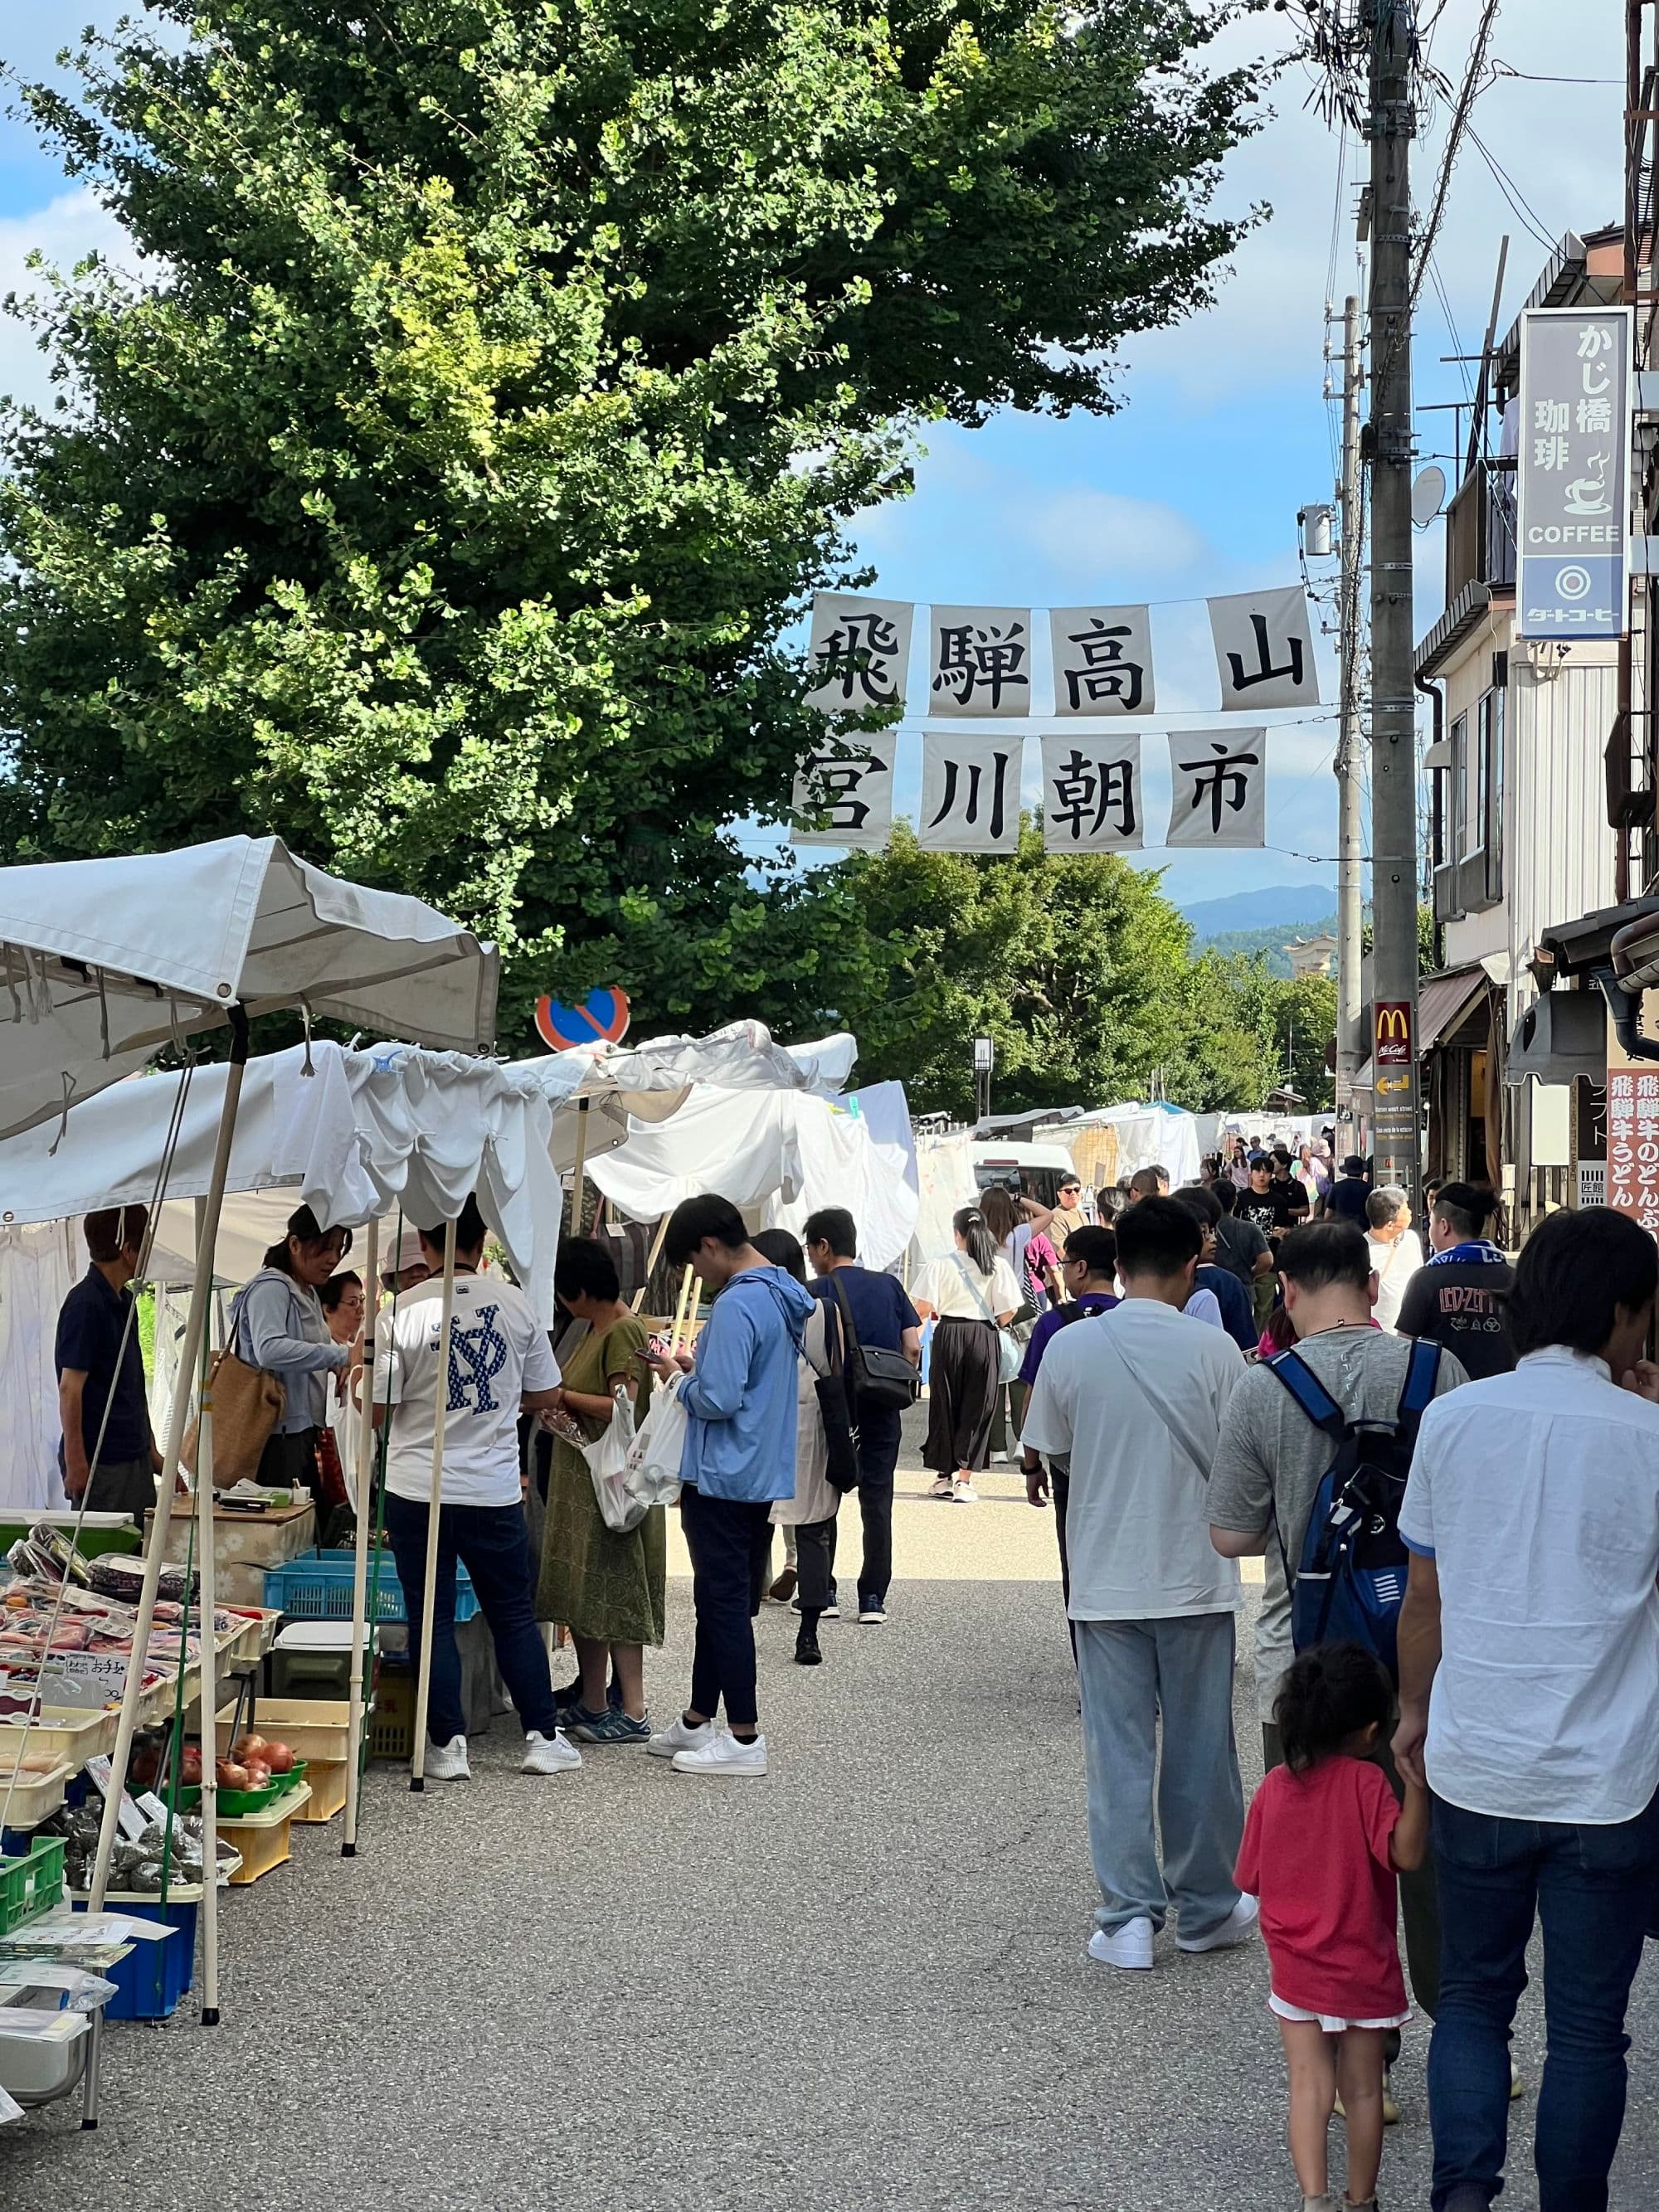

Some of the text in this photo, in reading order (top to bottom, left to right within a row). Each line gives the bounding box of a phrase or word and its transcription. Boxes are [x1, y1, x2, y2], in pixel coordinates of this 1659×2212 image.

[1575, 324, 1613, 433] かじ橋
[1534, 400, 1570, 471] 珈琲
[1528, 525, 1619, 544] COFFEE
[1611, 1075, 1635, 1207] 飛騨牛うどん
